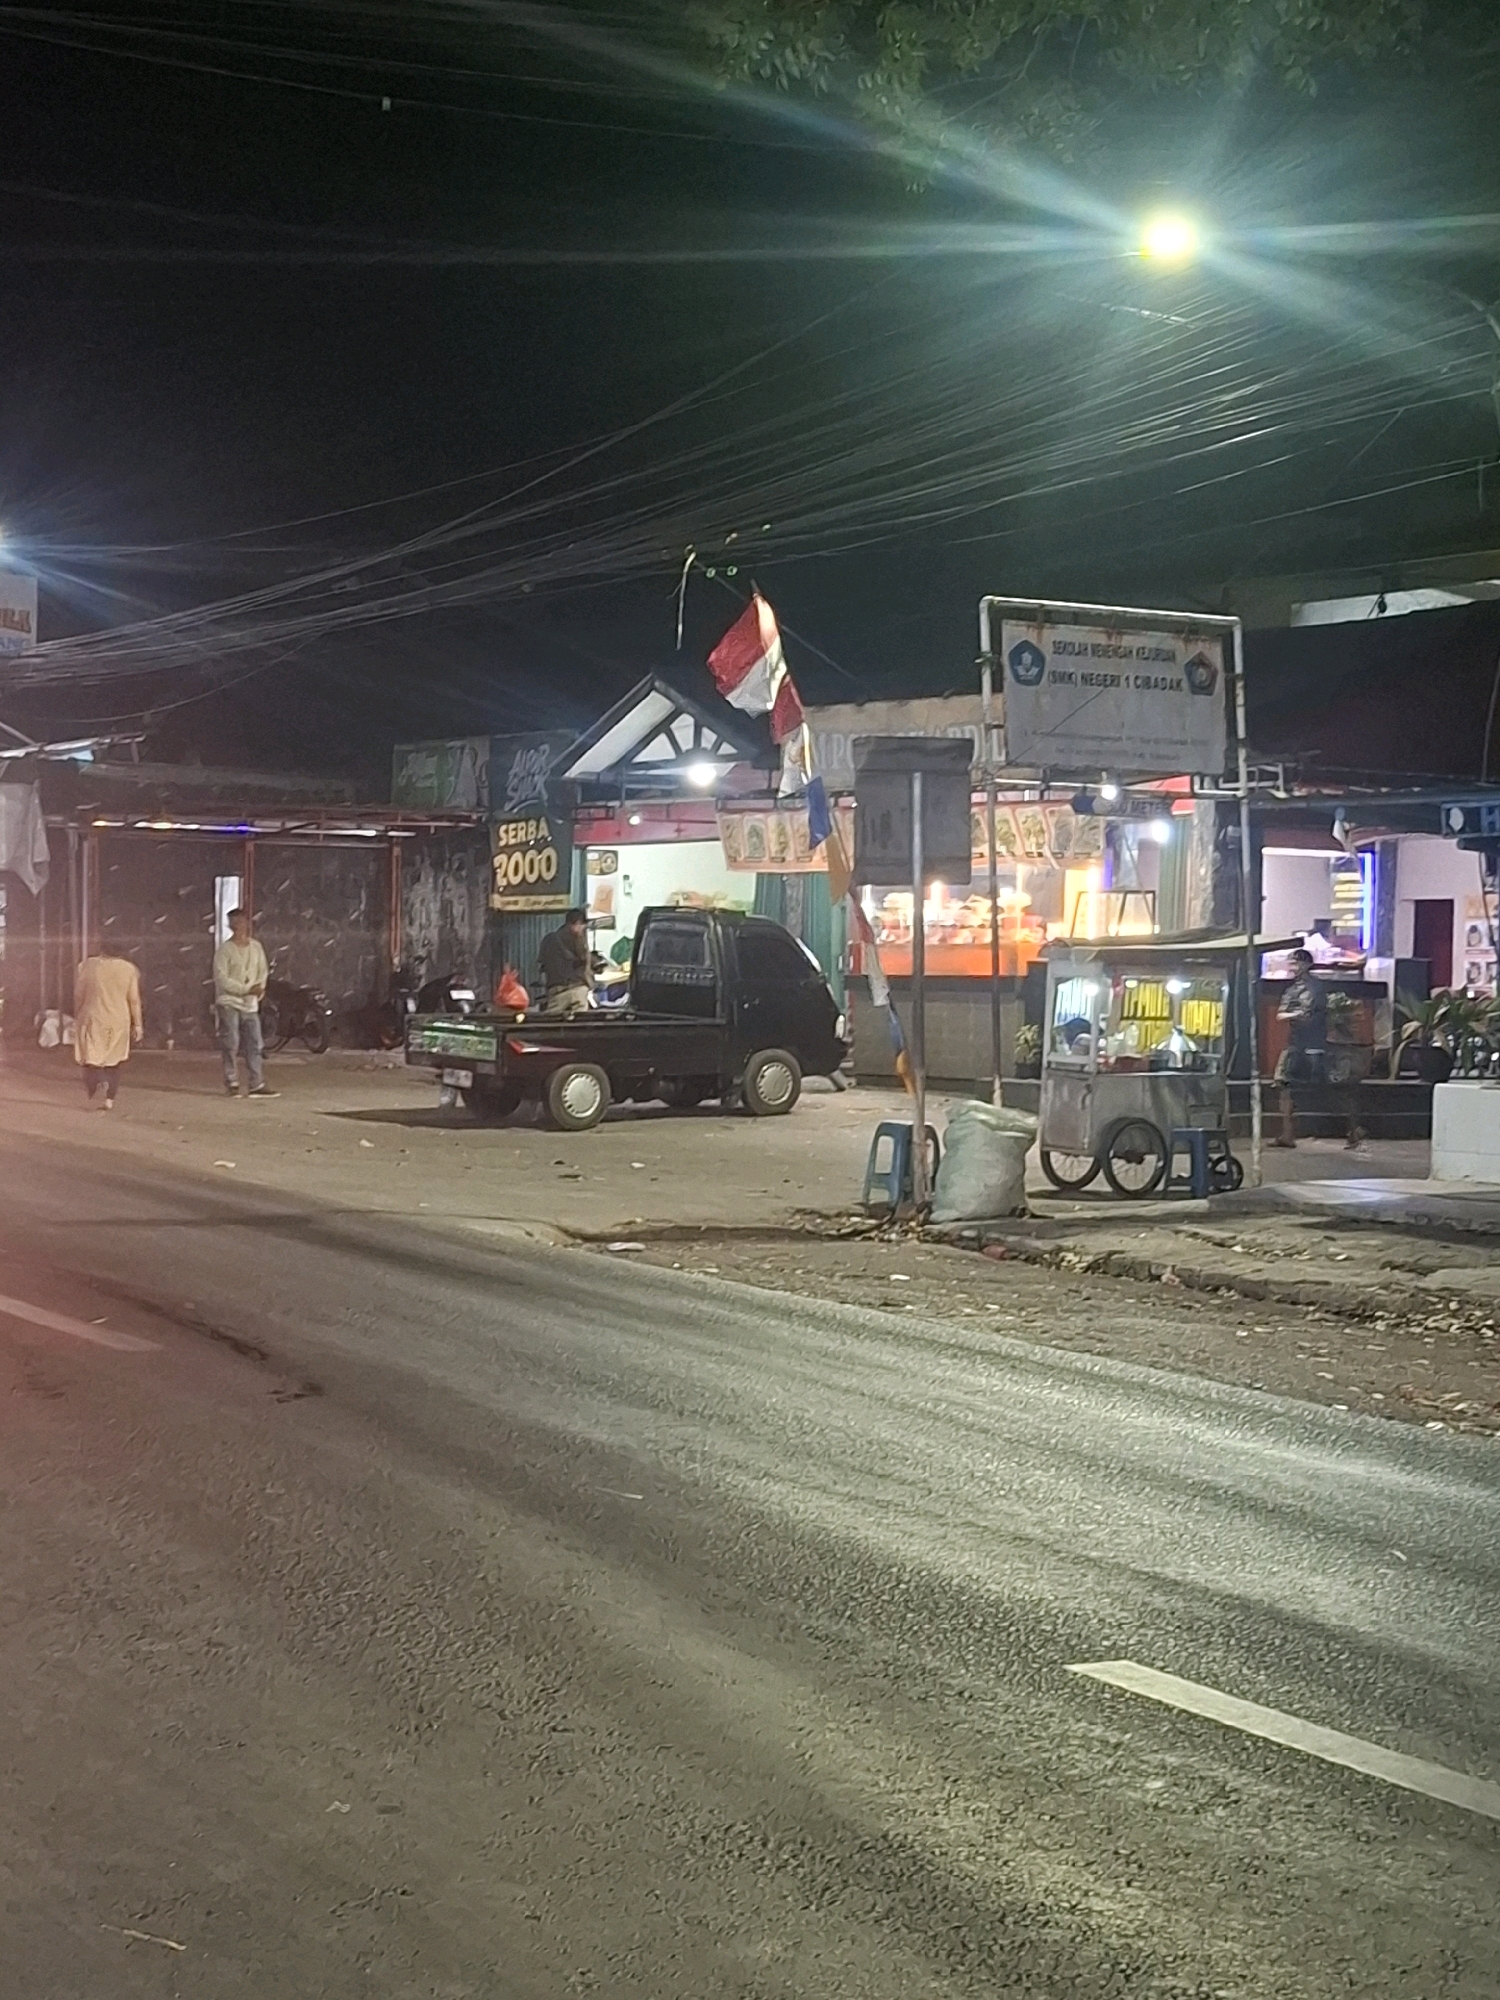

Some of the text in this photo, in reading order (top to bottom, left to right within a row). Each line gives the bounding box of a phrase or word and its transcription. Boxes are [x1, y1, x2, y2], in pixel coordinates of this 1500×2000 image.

[1052, 640, 1089, 657] SEKOLAH
[1048, 670, 1183, 692] (SMK) NEGERI 1 CIBADAK
[499, 816, 549, 846] SERBA
[494, 847, 558, 886] 2000
